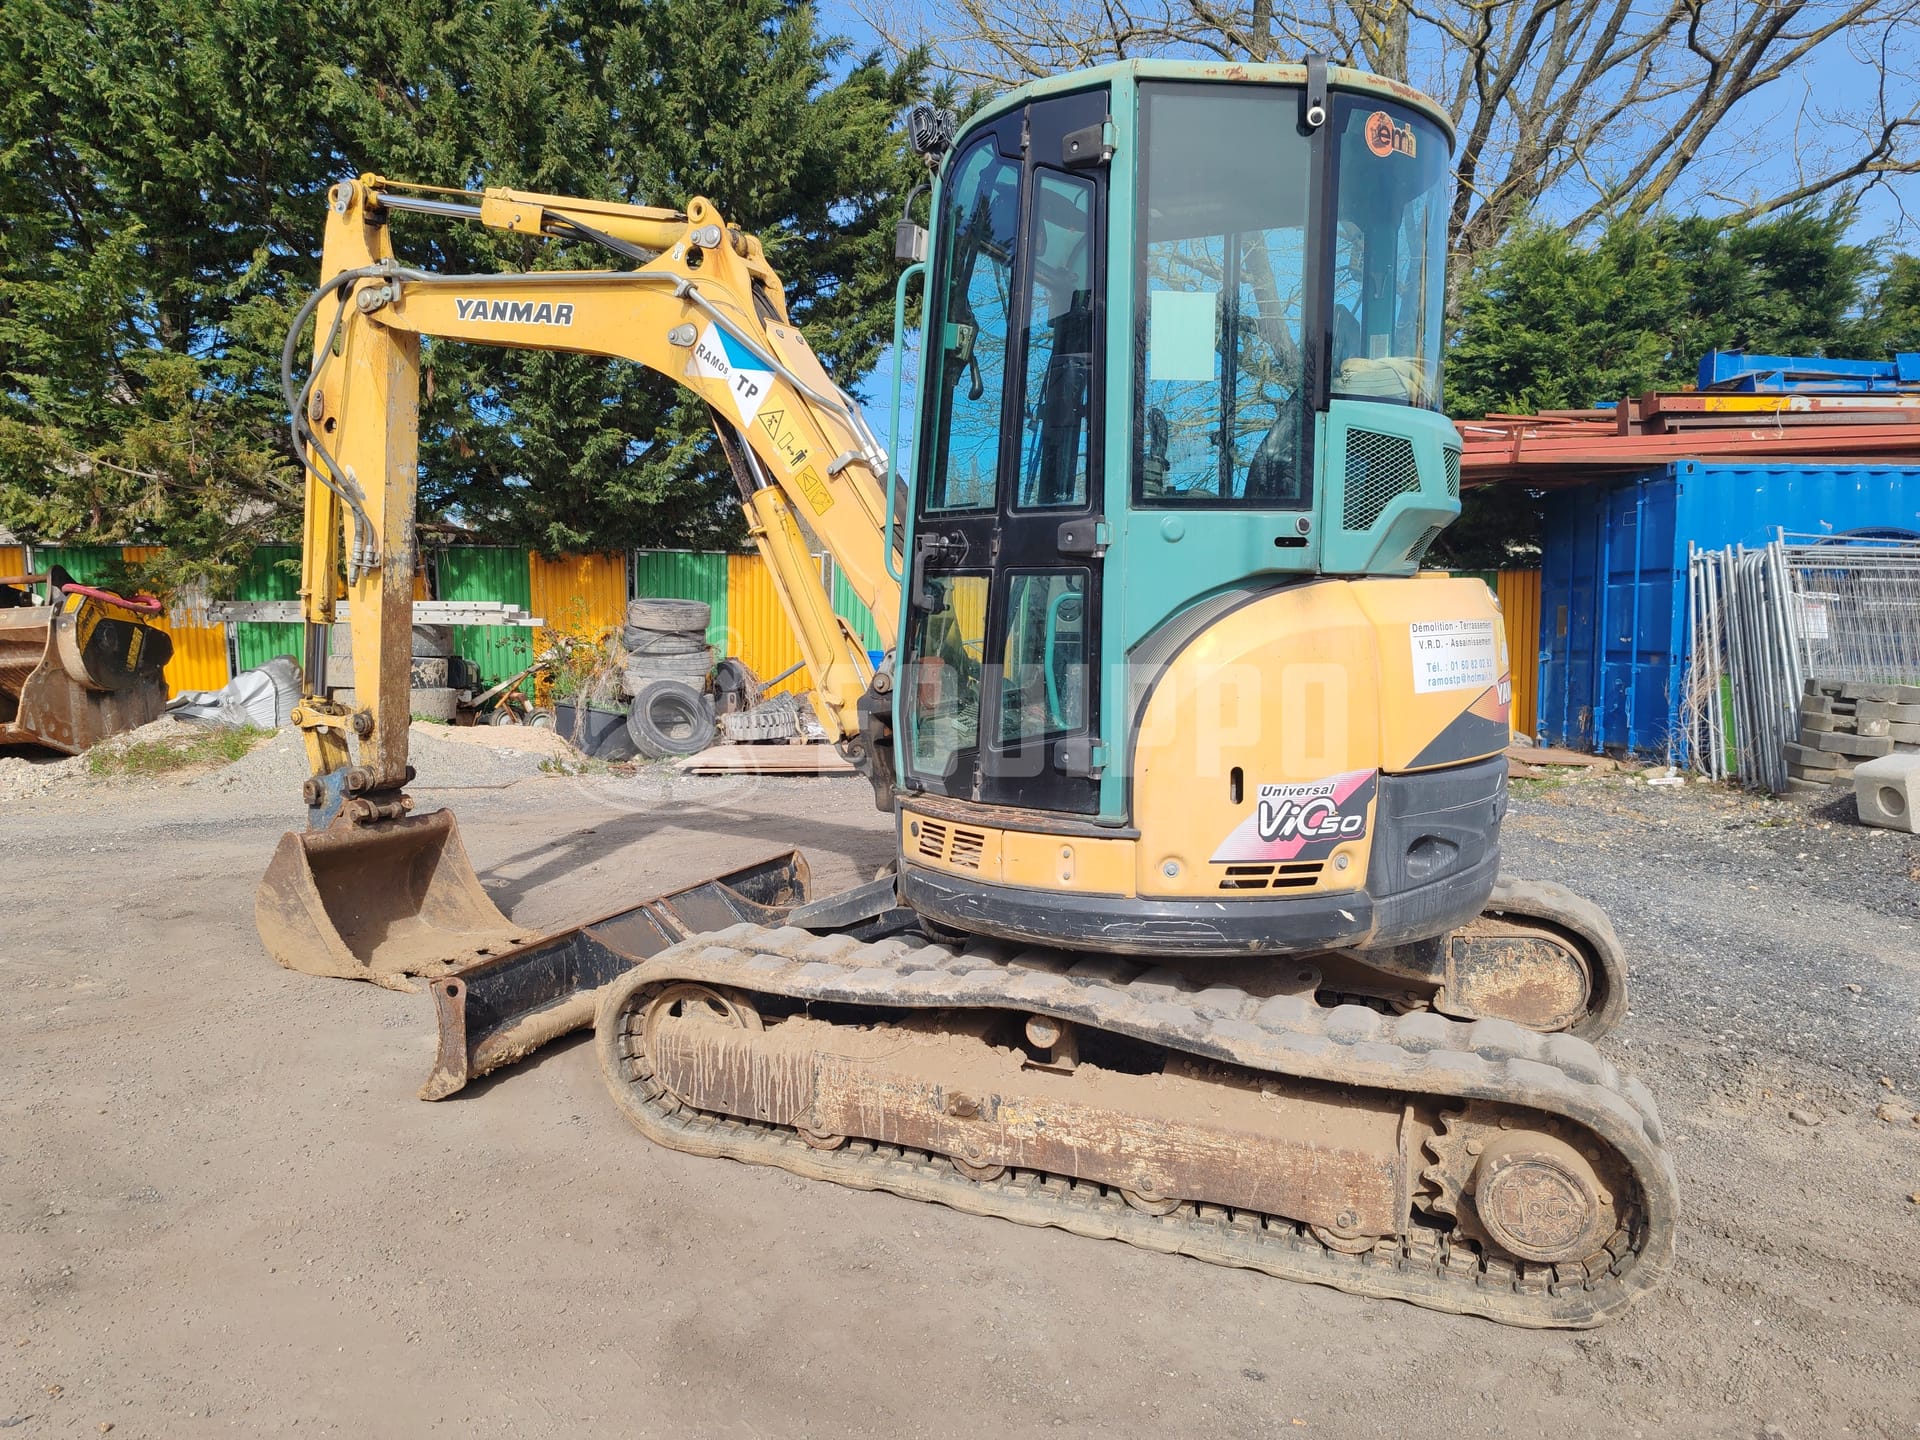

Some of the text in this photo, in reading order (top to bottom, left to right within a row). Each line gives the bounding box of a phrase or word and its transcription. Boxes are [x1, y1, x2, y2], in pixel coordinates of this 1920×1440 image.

[455, 298, 574, 326] YANMAR
[736, 373, 759, 399] TP
[1411, 622, 1454, 633] Démolition
[1418, 639, 1443, 650] V.R.D.
[1450, 660, 1459, 671] 01
[1261, 784, 1336, 797] Universal
